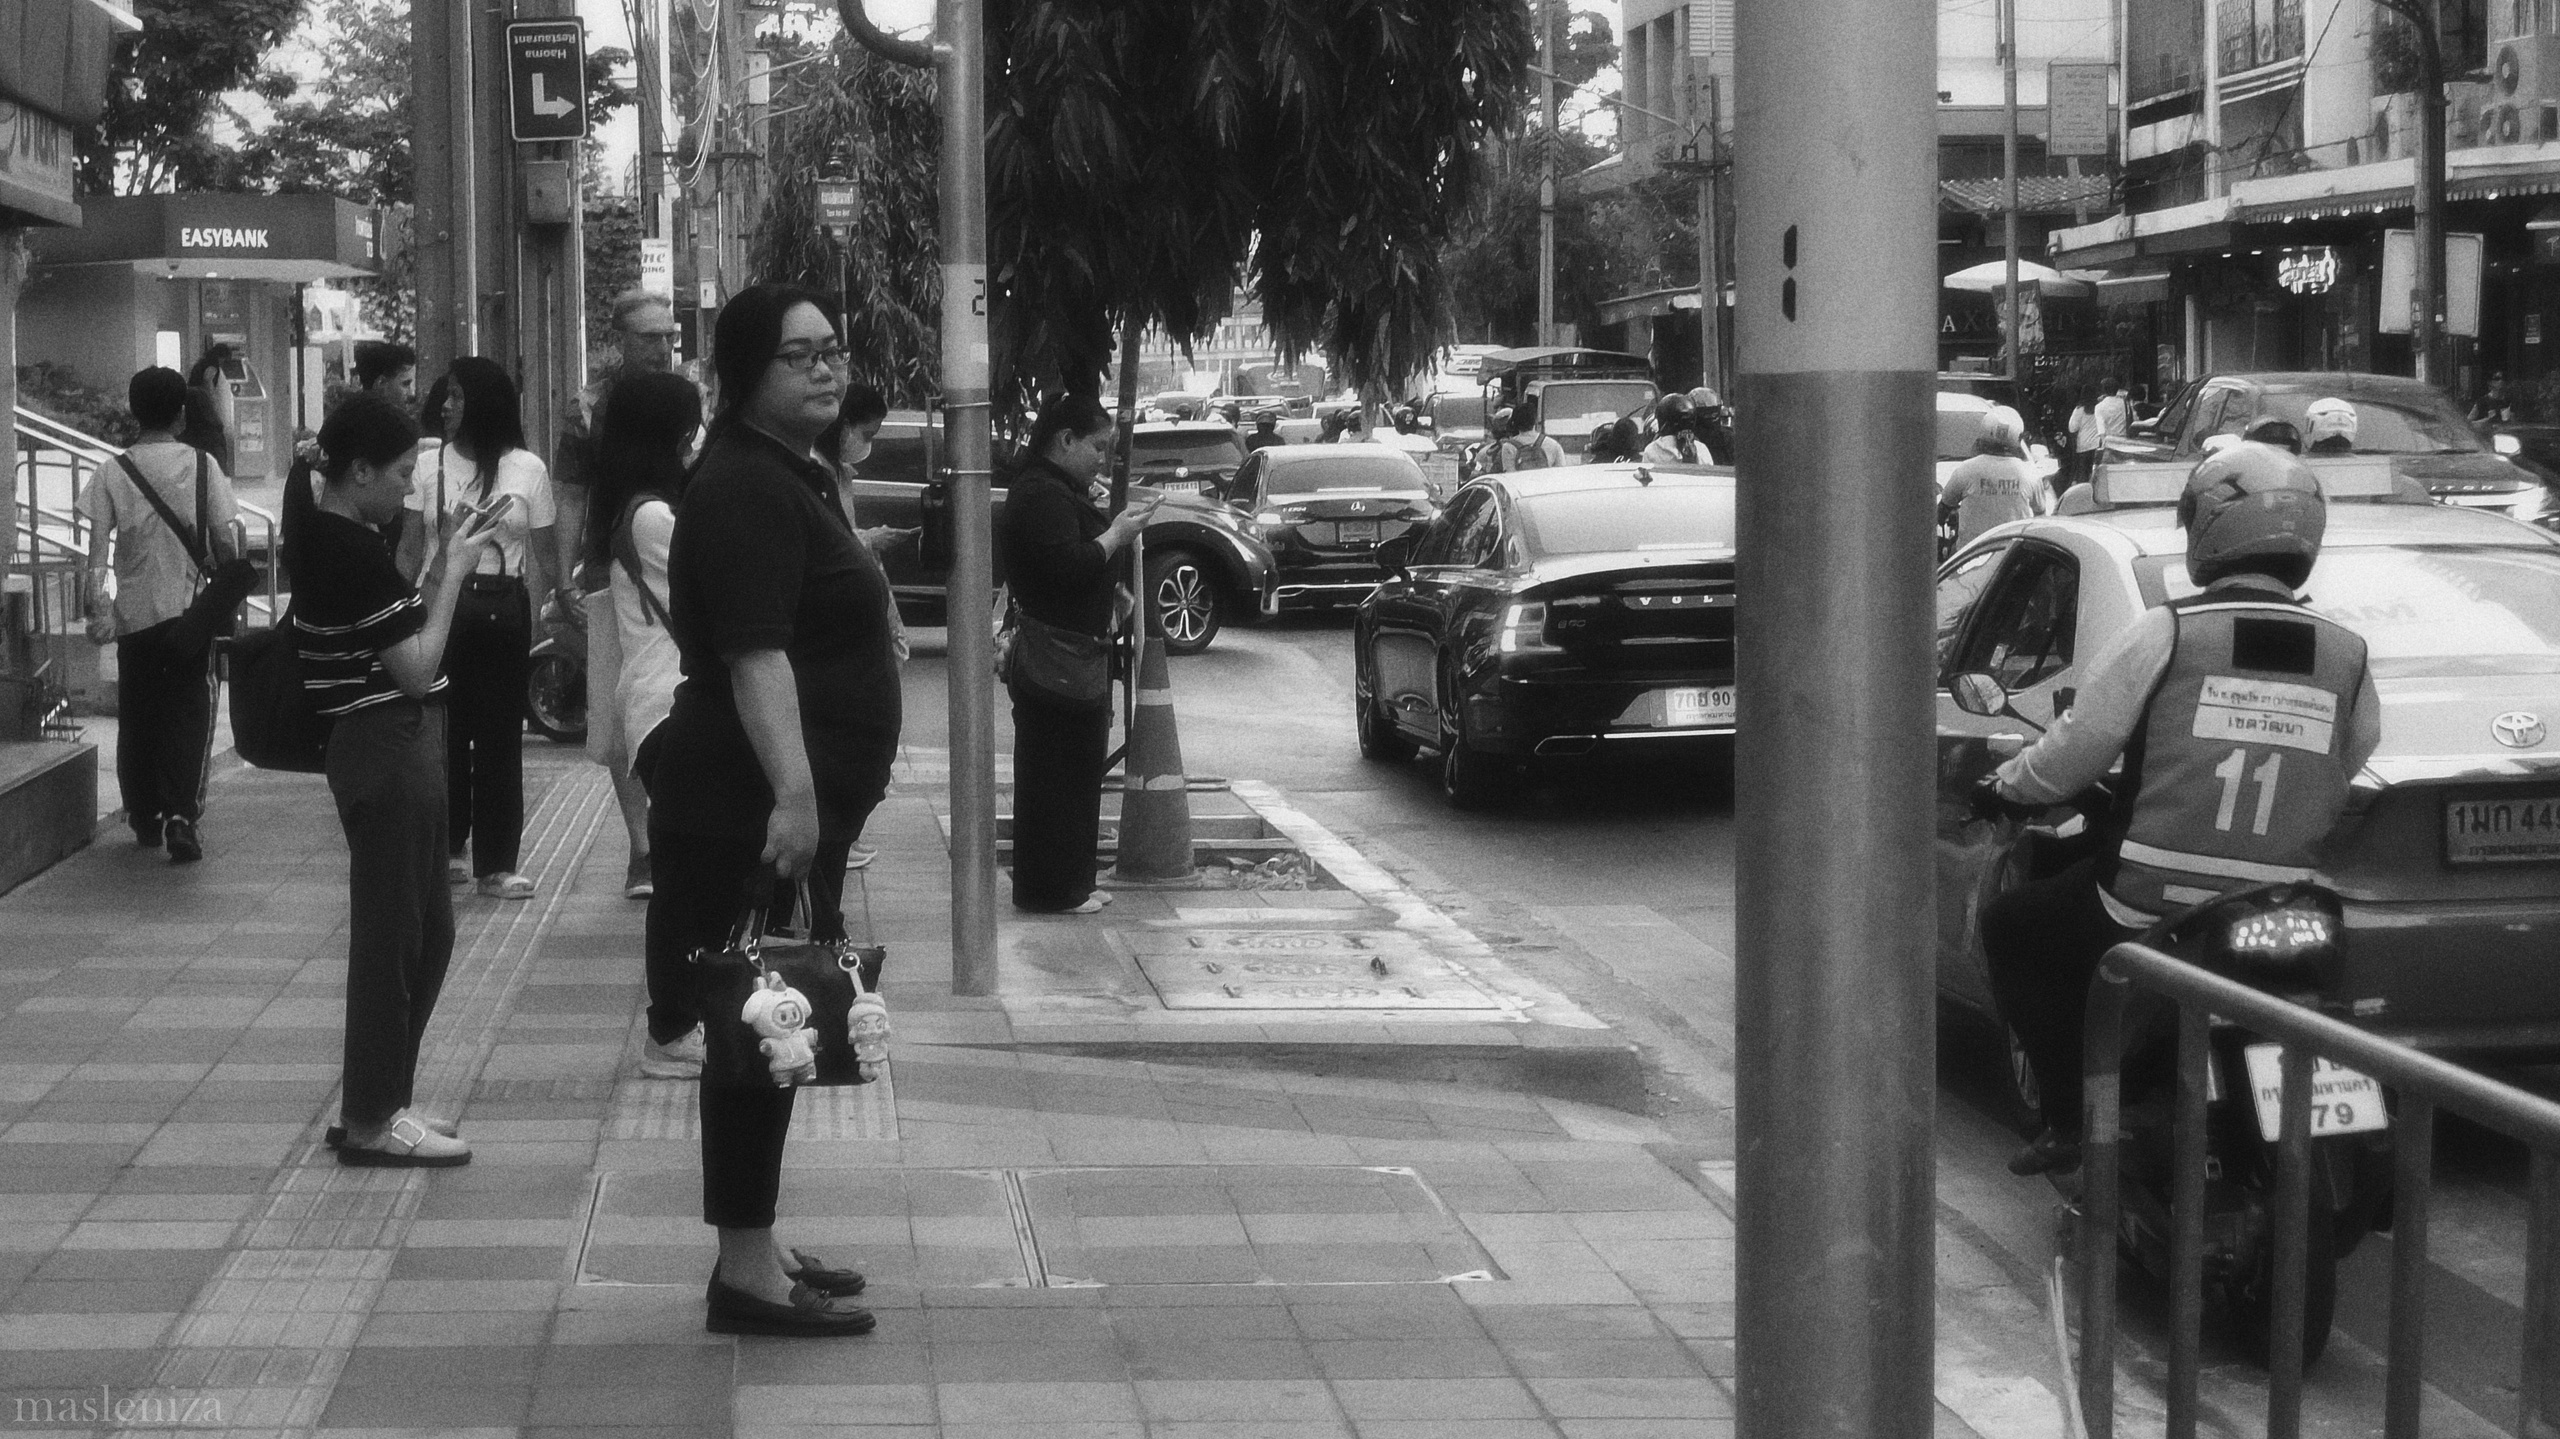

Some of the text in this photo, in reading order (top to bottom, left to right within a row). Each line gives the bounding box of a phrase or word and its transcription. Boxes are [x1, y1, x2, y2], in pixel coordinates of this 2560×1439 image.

[514, 33, 576, 44] Restaurant
[525, 48, 567, 59] Haoma
[181, 227, 269, 248] EASYBANK
[1639, 594, 1736, 606] VOL
[1711, 691, 1736, 707] 90
[2214, 747, 2282, 836] 11
